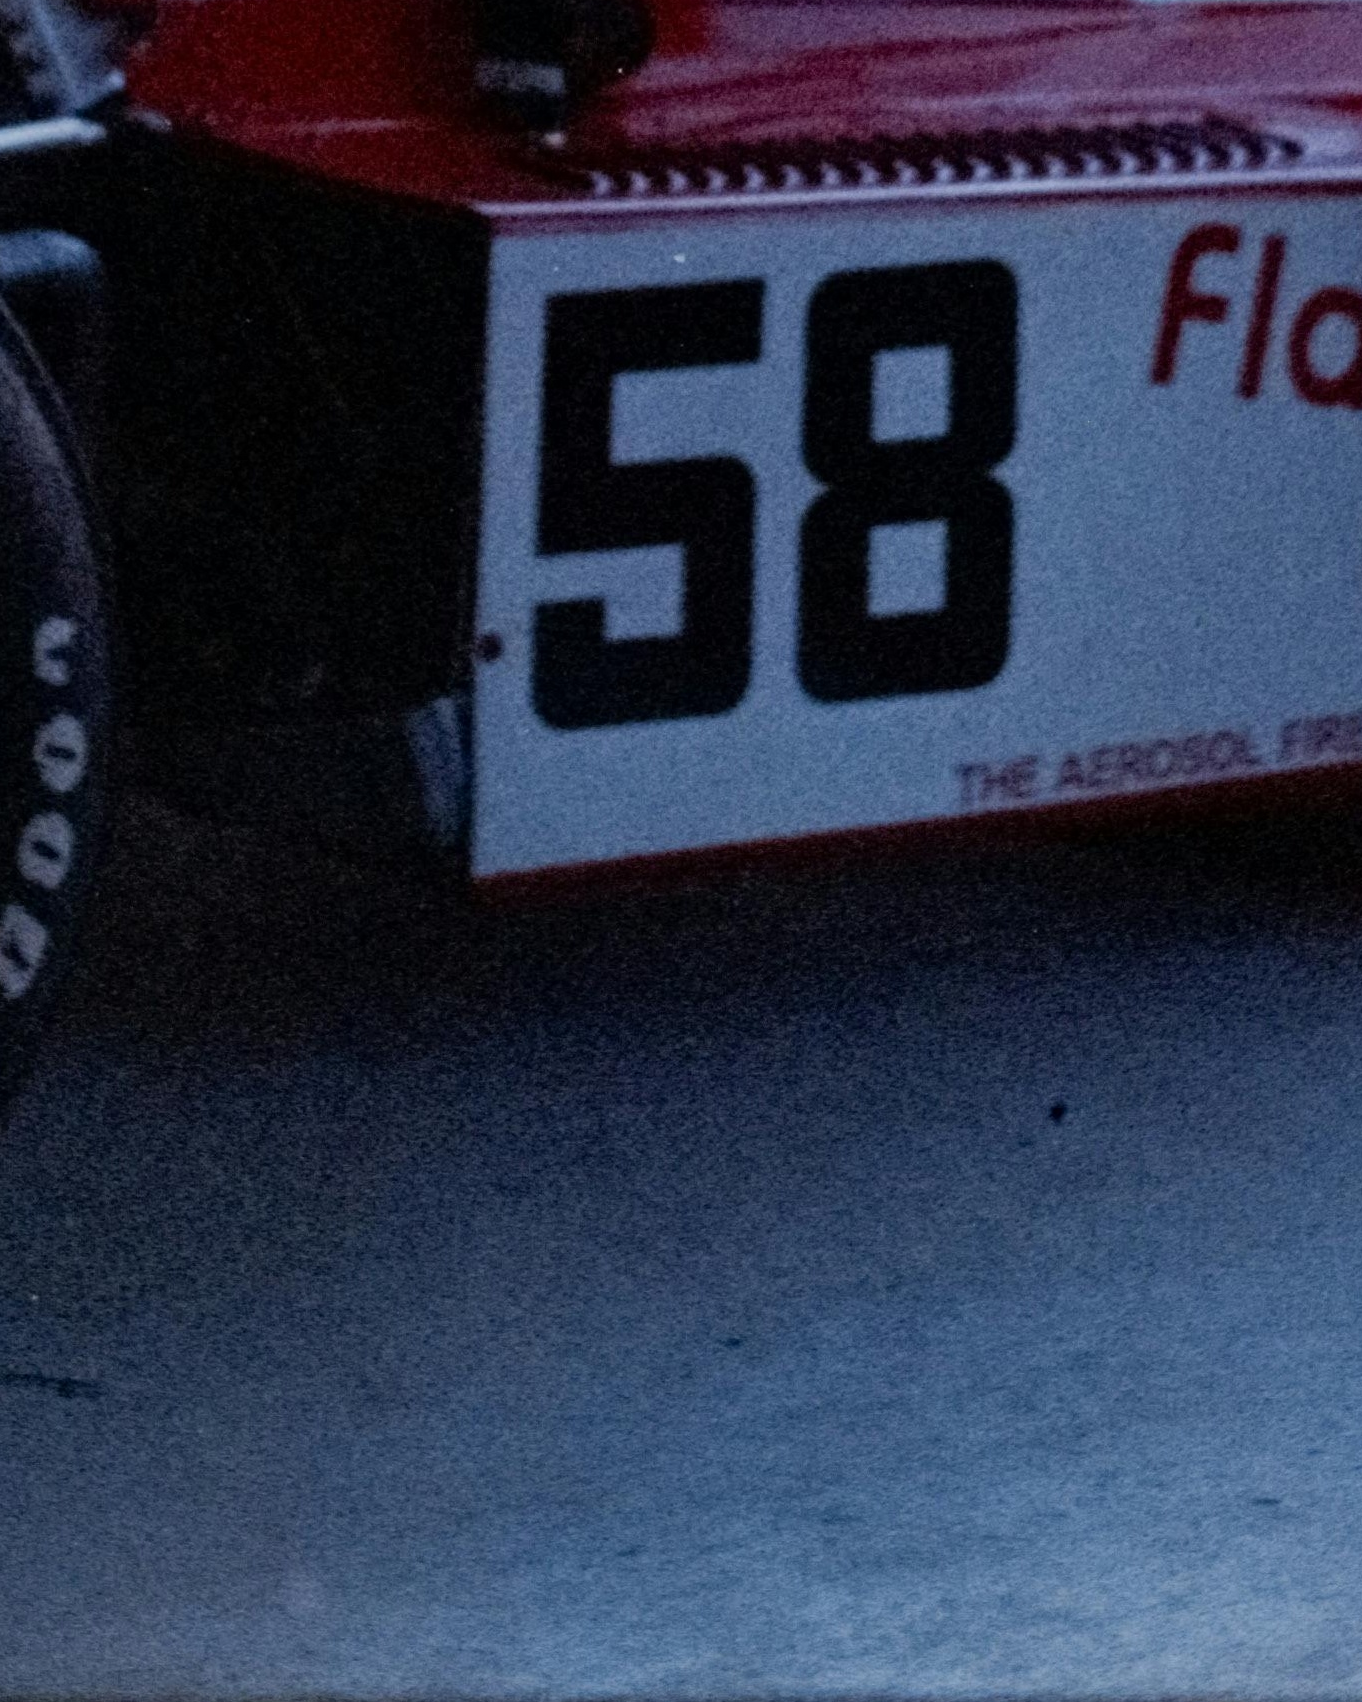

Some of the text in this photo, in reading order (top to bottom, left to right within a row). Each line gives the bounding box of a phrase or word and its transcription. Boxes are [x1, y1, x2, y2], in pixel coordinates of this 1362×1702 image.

[532, 256, 1020, 731] 58
[953, 755, 1038, 808] THE
[1053, 730, 1261, 792] AEROSOL
